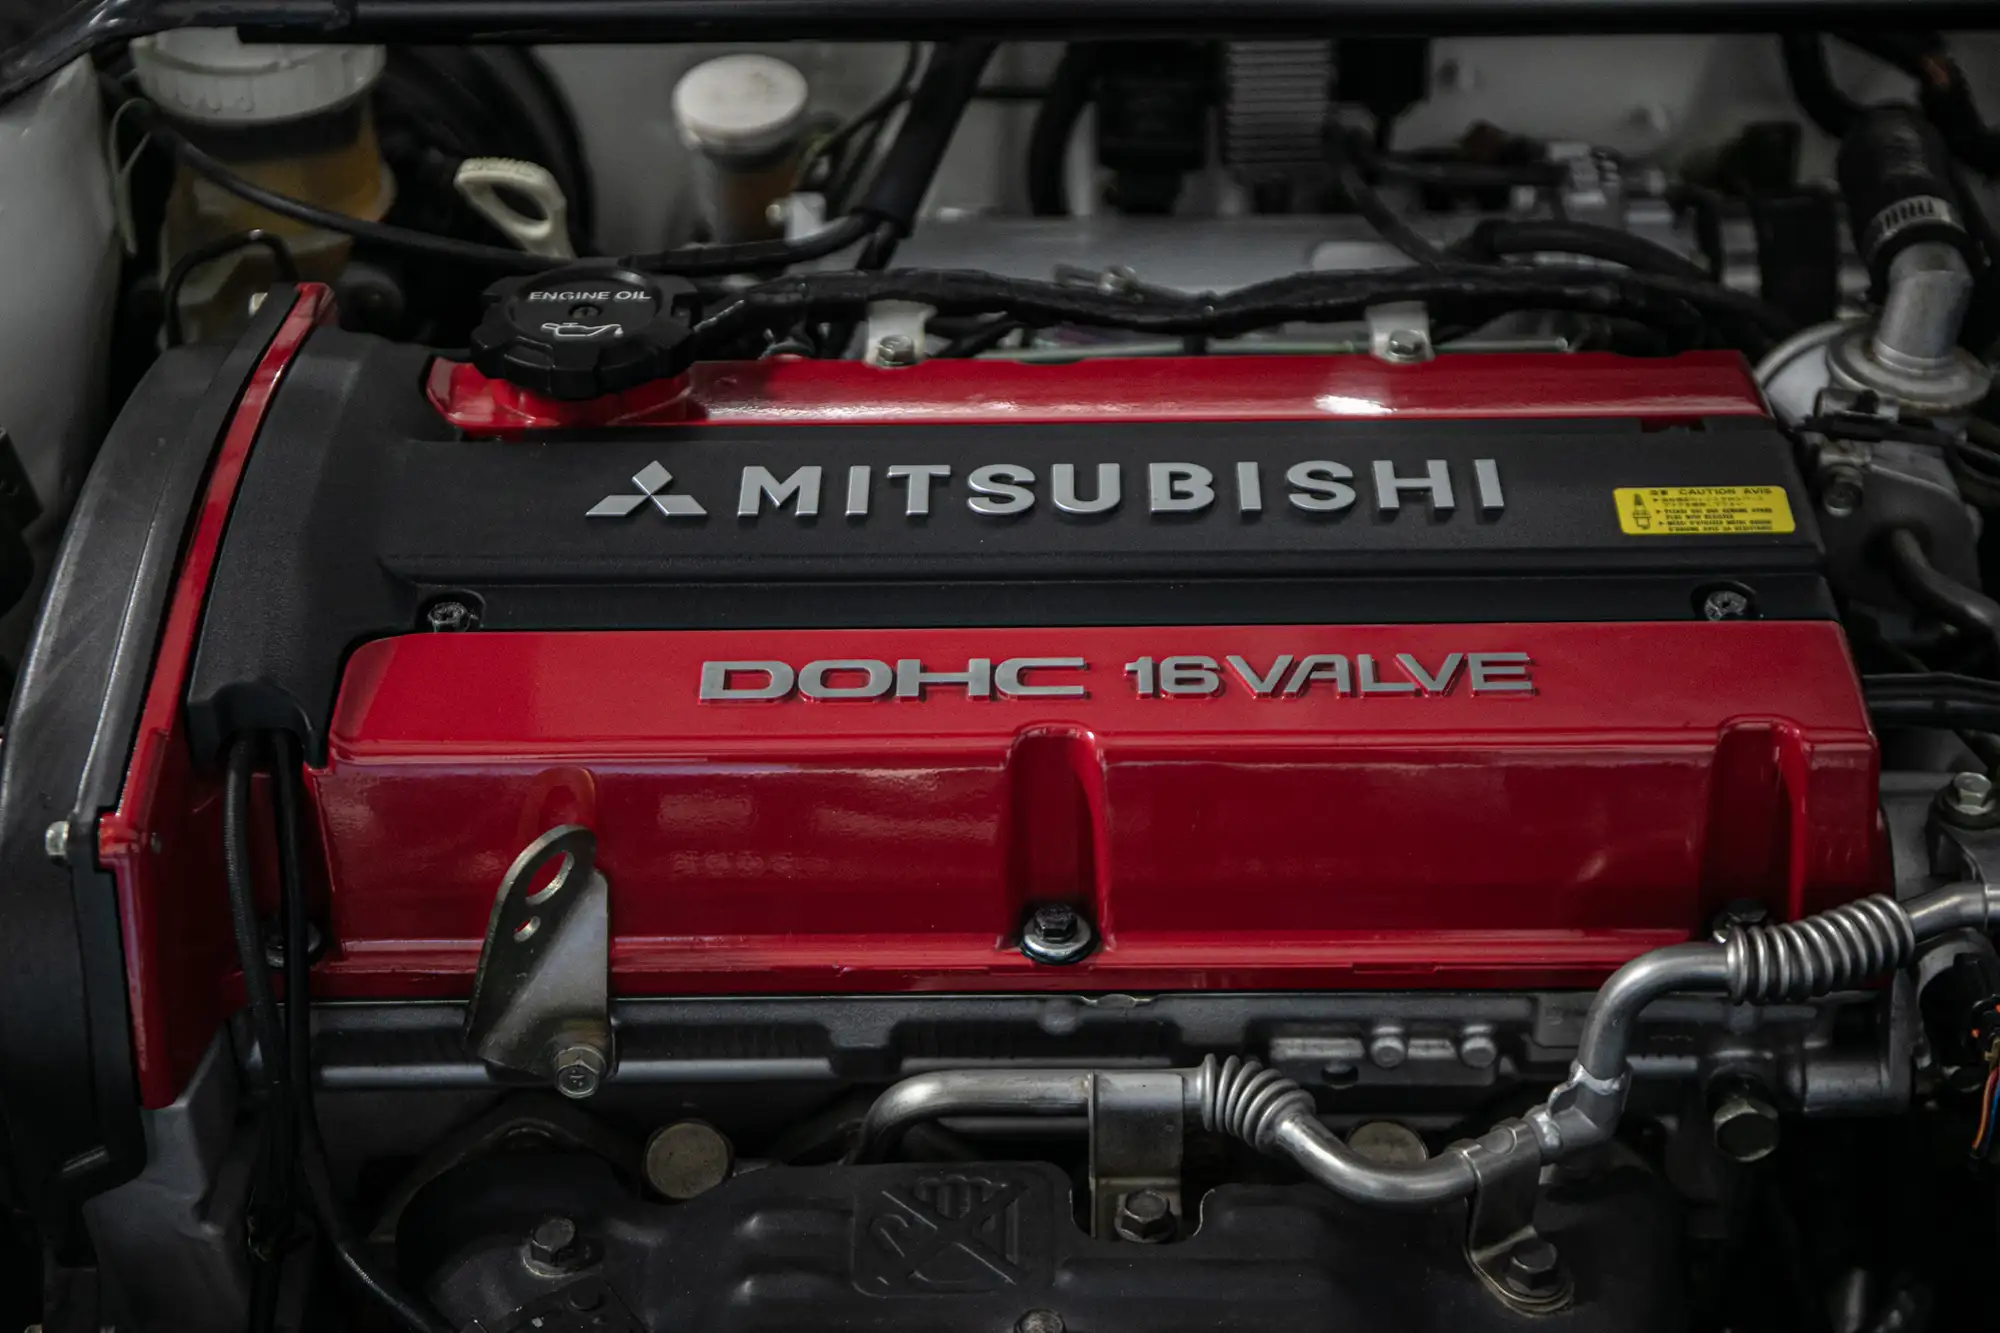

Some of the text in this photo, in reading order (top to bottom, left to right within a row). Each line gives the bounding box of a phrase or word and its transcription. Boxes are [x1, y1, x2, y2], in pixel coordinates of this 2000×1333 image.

[528, 290, 652, 301] ENGINE OIL
[737, 458, 1505, 517] MITSUBISHI
[1678, 487, 1736, 496] CAUTION
[1743, 487, 1773, 495] AVIS
[697, 656, 1087, 702] DOHC
